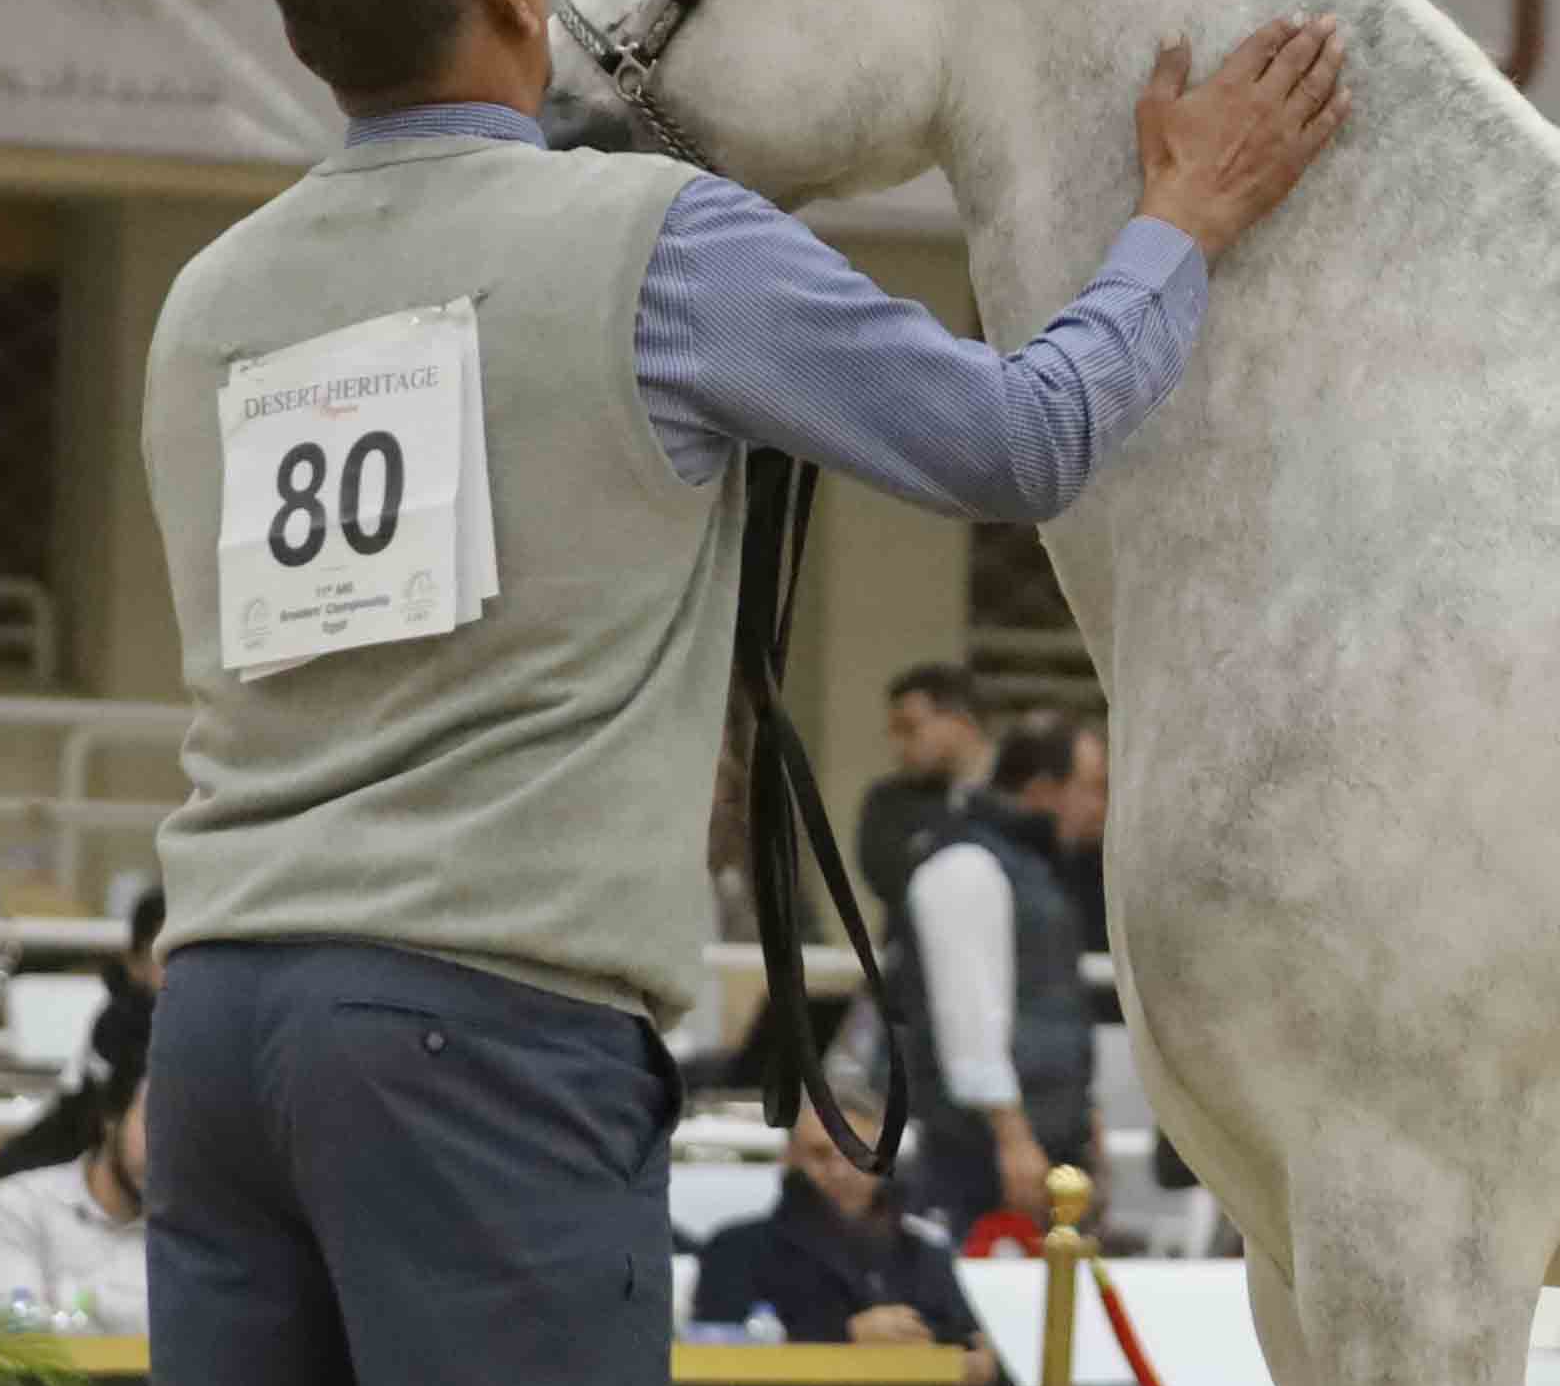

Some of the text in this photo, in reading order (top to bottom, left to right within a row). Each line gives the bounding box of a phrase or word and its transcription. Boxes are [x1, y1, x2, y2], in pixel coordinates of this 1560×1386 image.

[244, 384, 321, 420] DESERT
[327, 365, 440, 406] HERITAGE
[267, 429, 405, 569] 80
